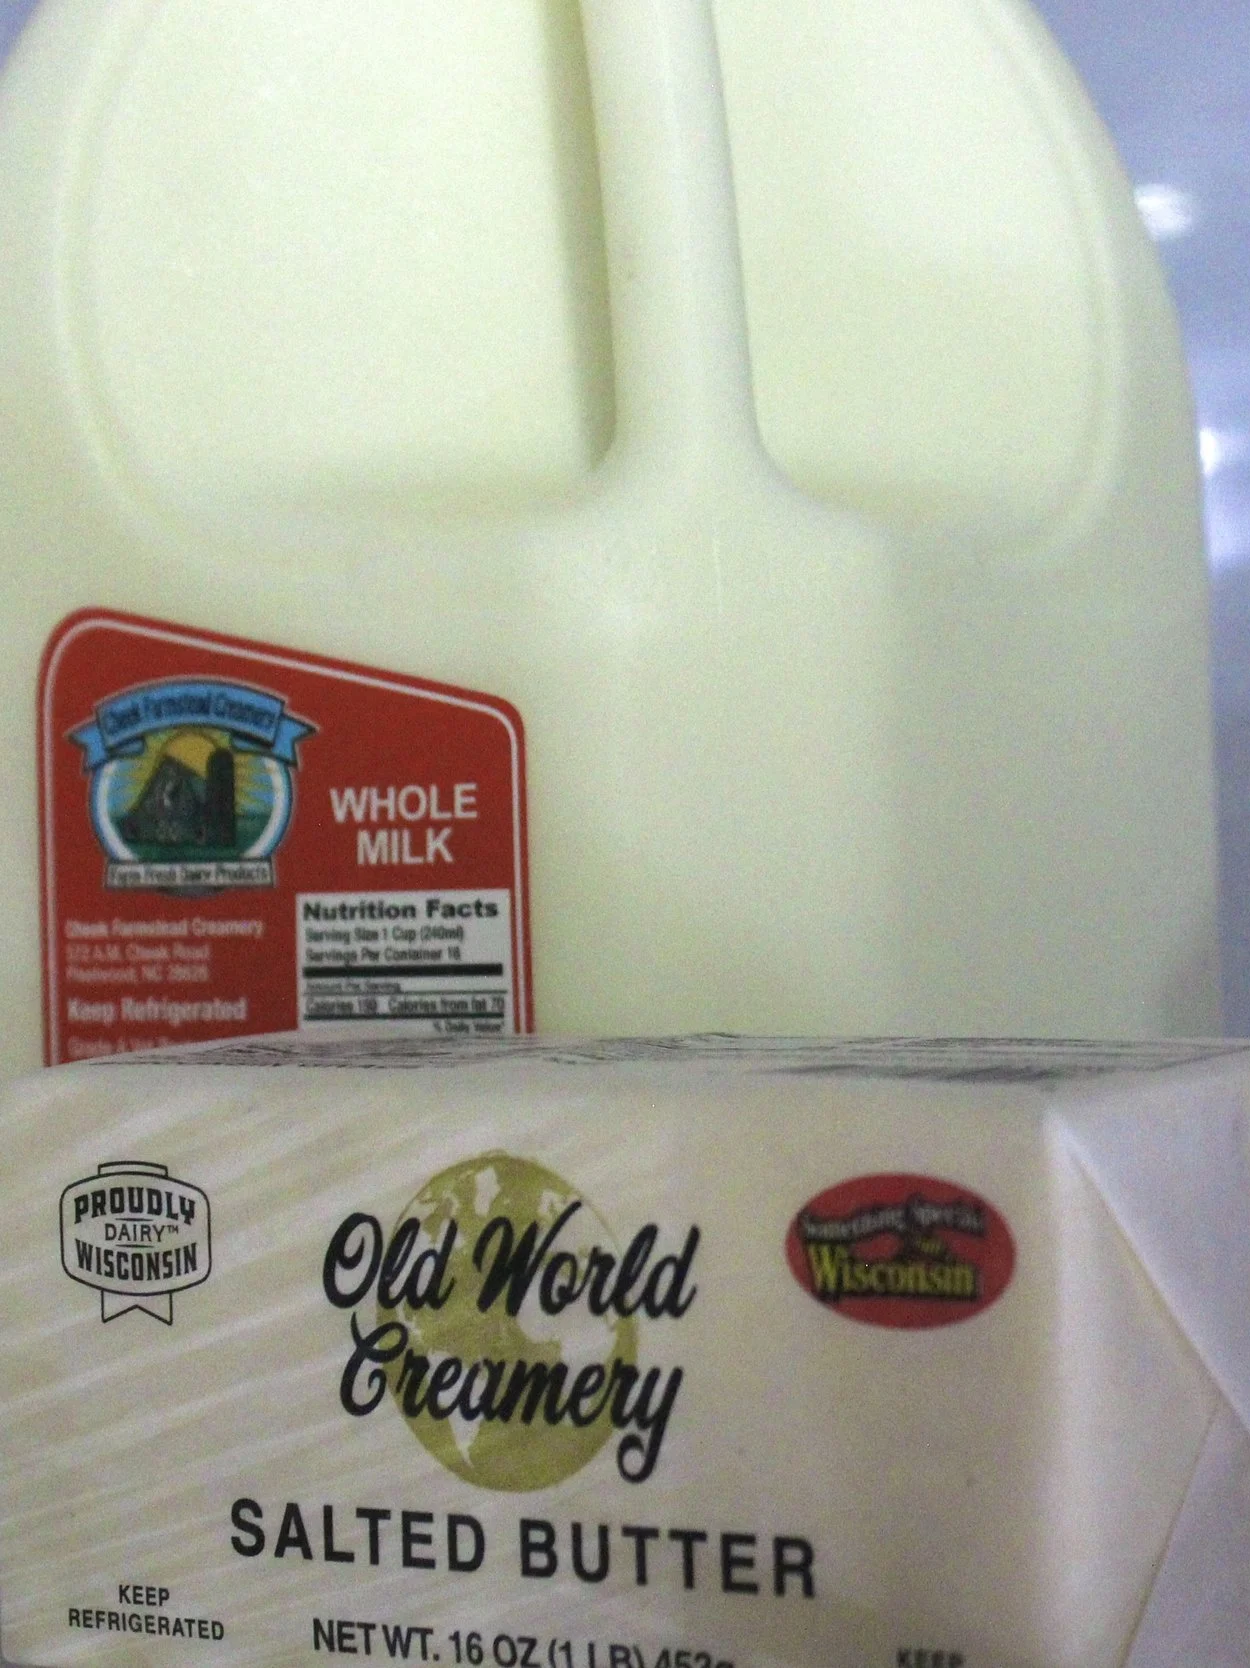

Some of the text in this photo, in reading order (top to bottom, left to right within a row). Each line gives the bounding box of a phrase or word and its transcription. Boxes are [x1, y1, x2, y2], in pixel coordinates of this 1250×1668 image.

[329, 782, 478, 823] WHOLE
[356, 825, 454, 866] MILK
[303, 898, 499, 921] Nutrition Facts
[361, 948, 380, 962] Per
[384, 947, 442, 962] Container
[392, 926, 417, 942] Cup
[67, 997, 248, 1028] Keep Refrigerated
[73, 1186, 196, 1225] PROUDLY
[75, 1238, 198, 1282] WISCONSIN
[322, 1201, 701, 1319] Old World
[807, 1244, 975, 1296] Wisconsin
[339, 1312, 684, 1484] Creamery
[230, 1498, 816, 1599] SALTED BUTTER
[118, 1584, 170, 1608] KEEP
[68, 1607, 225, 1641] REFRIGERATED
[312, 1617, 377, 1656] NET
[381, 1623, 441, 1662] WT.
[448, 1631, 485, 1665] 16
[492, 1634, 542, 1667] OZ
